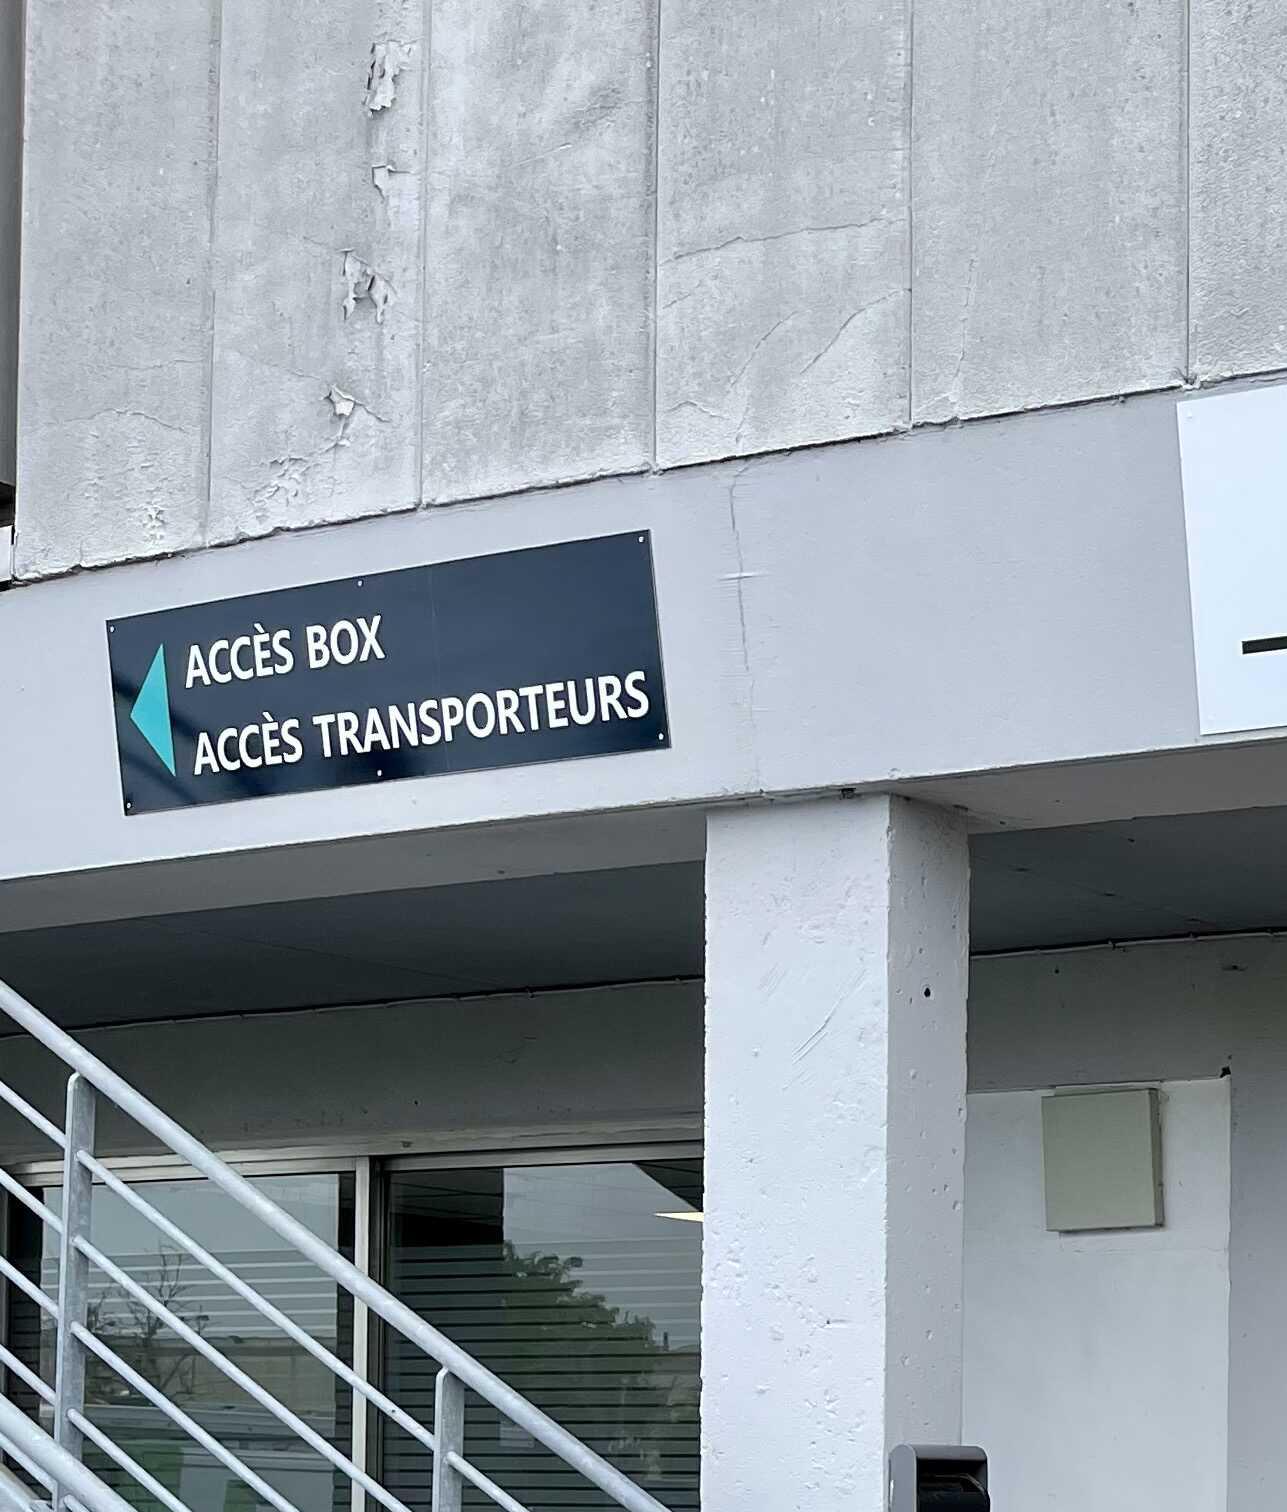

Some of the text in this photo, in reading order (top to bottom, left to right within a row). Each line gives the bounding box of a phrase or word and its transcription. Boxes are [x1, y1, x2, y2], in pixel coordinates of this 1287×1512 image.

[184, 613, 386, 689] ACCÈS BOX
[192, 669, 650, 776] ACCÈS TRANSPORTEURS
